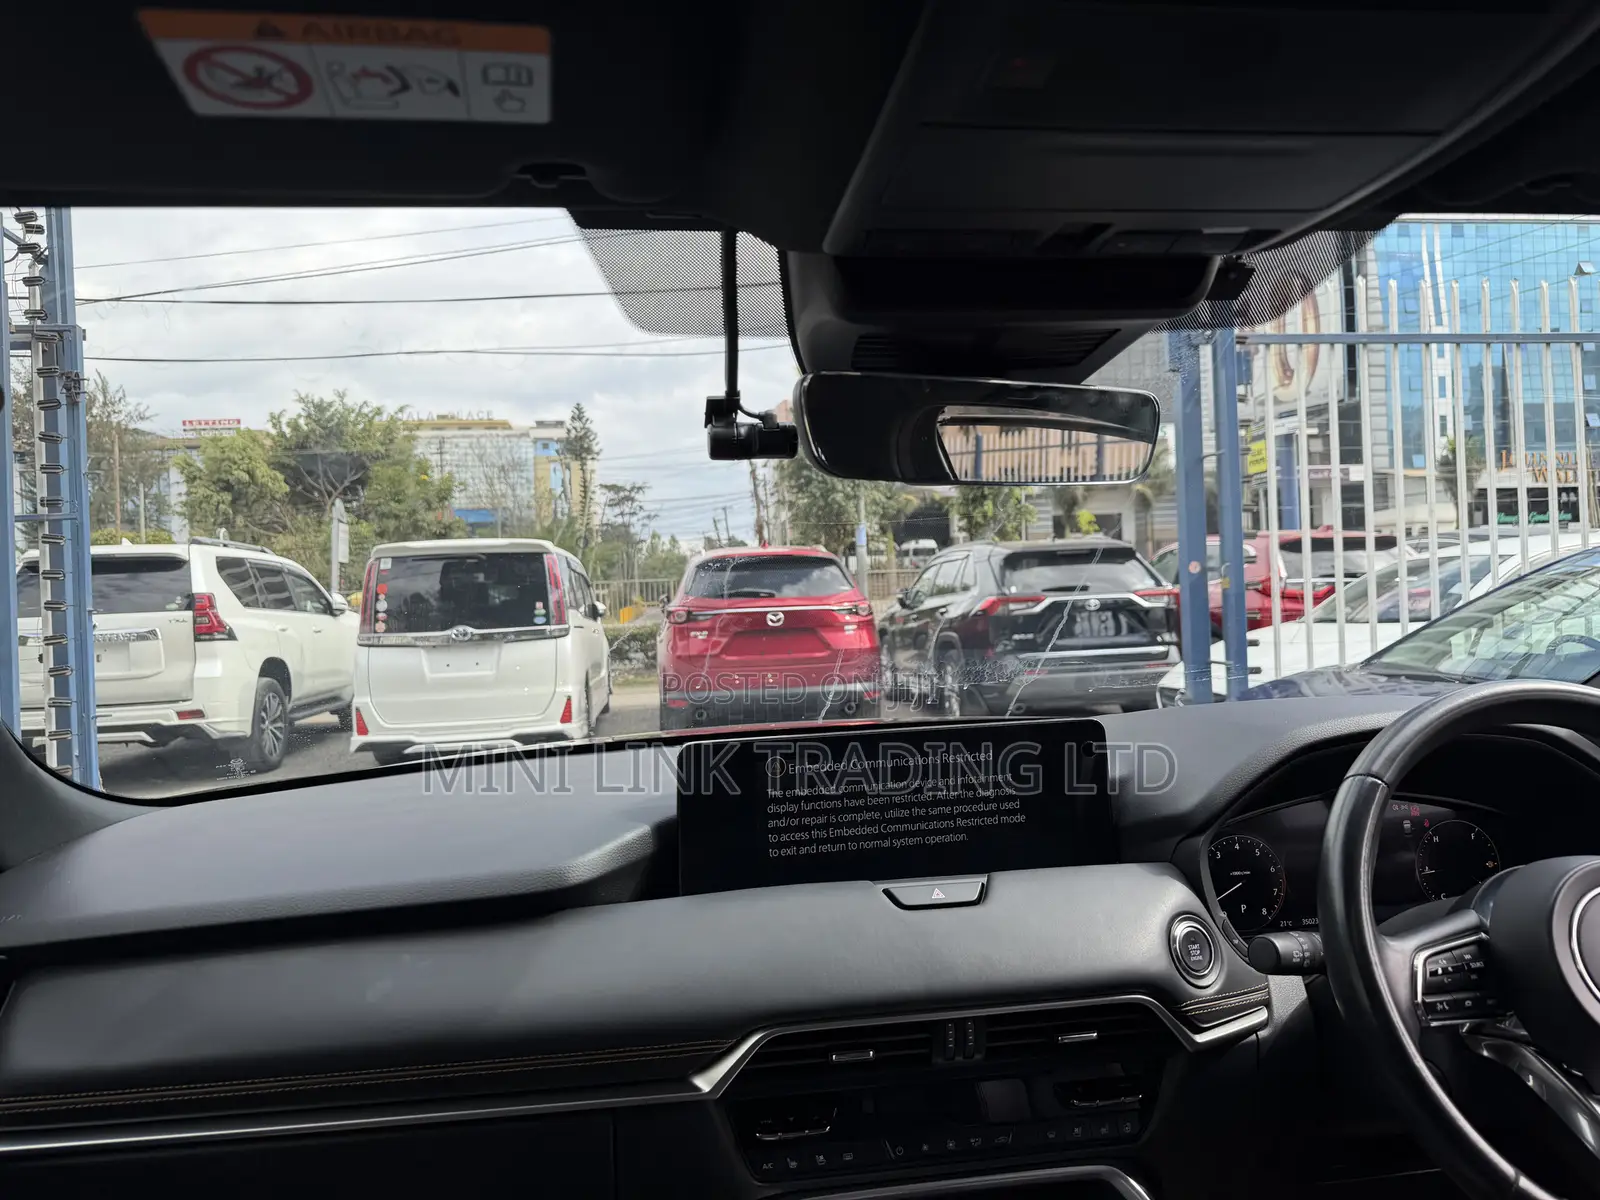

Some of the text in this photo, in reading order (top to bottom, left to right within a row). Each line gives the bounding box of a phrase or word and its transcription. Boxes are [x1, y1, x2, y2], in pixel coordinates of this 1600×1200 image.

[302, 21, 462, 46] AIRBAG
[788, 750, 993, 774] Embedded Communications Restricted
[768, 773, 1012, 798] The embedded communication device and infotainment
[767, 786, 1016, 814] display functions have been restricted. After the diagnosis
[768, 799, 1020, 828] and/or repair is complete, utilize the same procedure used
[768, 813, 1026, 842] to access this Embedded Communications Restricted mode
[769, 833, 968, 857] to exit and return to normal system operation.
[1216, 851, 1221, 859] 3
[1241, 904, 1247, 913] P
[762, 1162, 774, 1170] A/C
